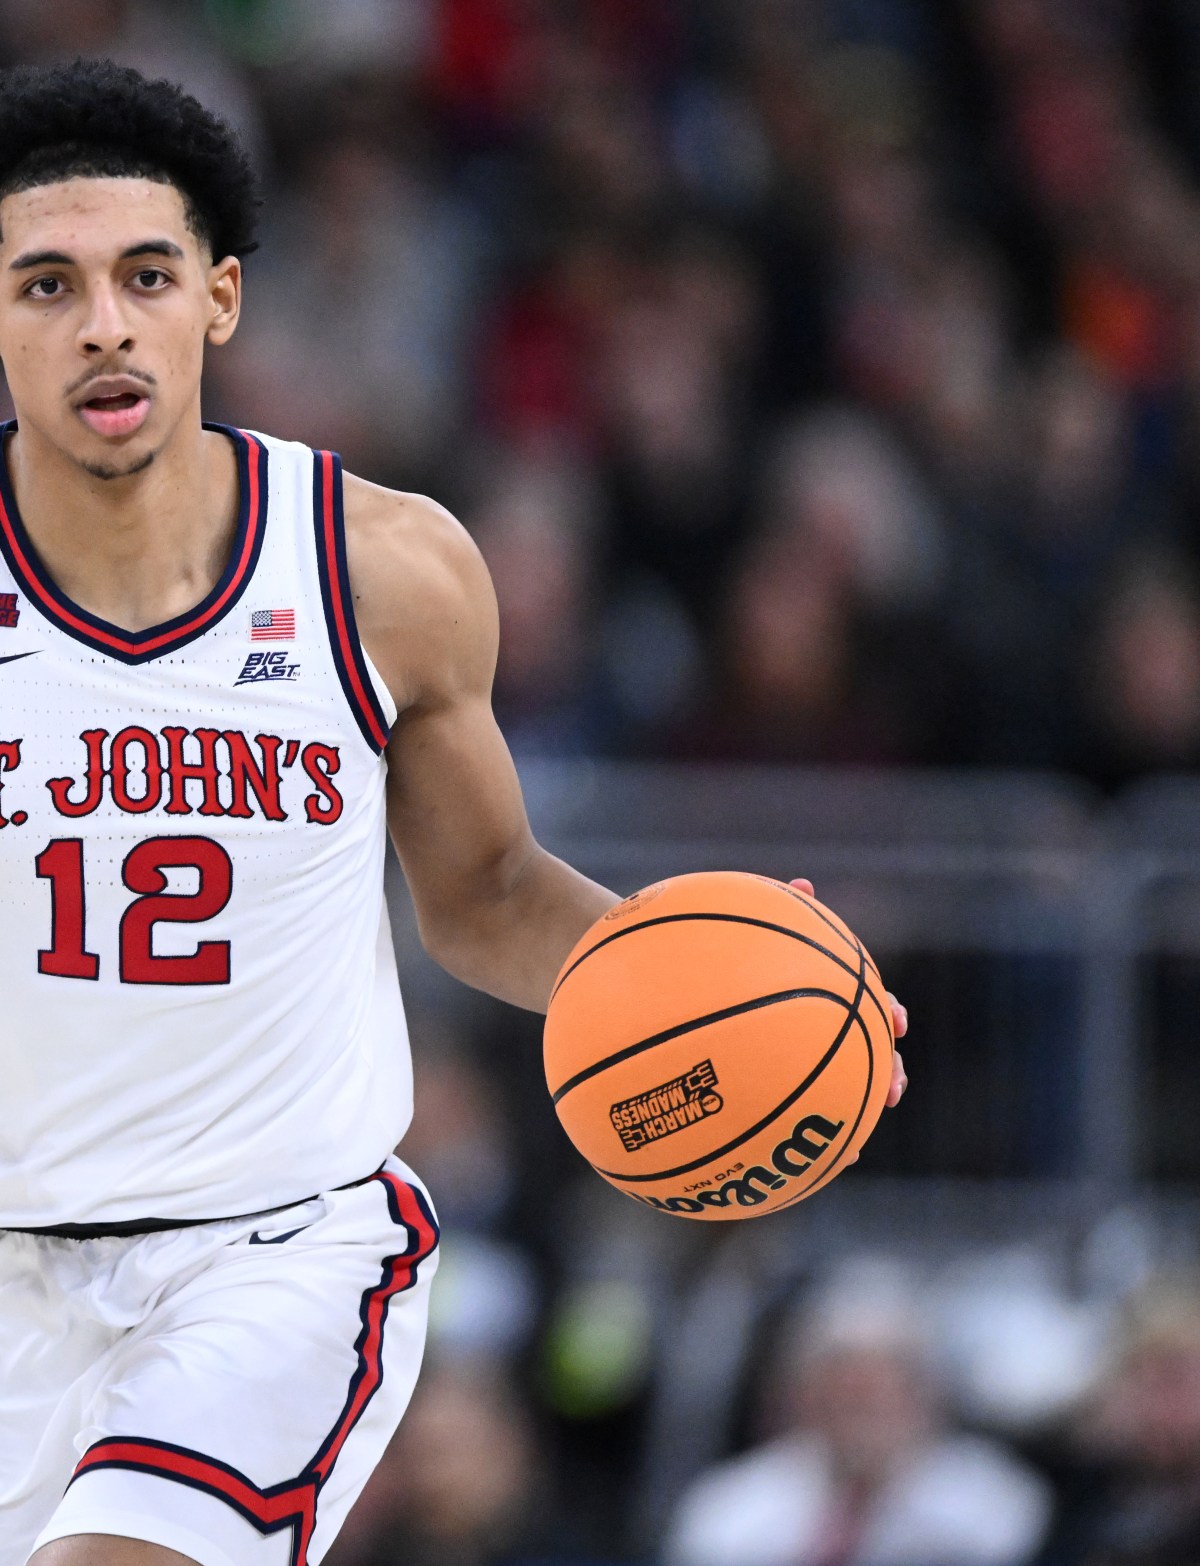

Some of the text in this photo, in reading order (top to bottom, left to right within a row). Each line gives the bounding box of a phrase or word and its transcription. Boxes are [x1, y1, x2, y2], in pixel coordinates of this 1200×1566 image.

[238, 664, 300, 679] EAST
[245, 652, 288, 666] BIG
[45, 725, 344, 826] JOHN'S
[34, 834, 234, 985] 12
[612, 1086, 686, 1130] MADNESS
[643, 1100, 703, 1139] MARCH
[684, 1162, 744, 1193] EVO NXT
